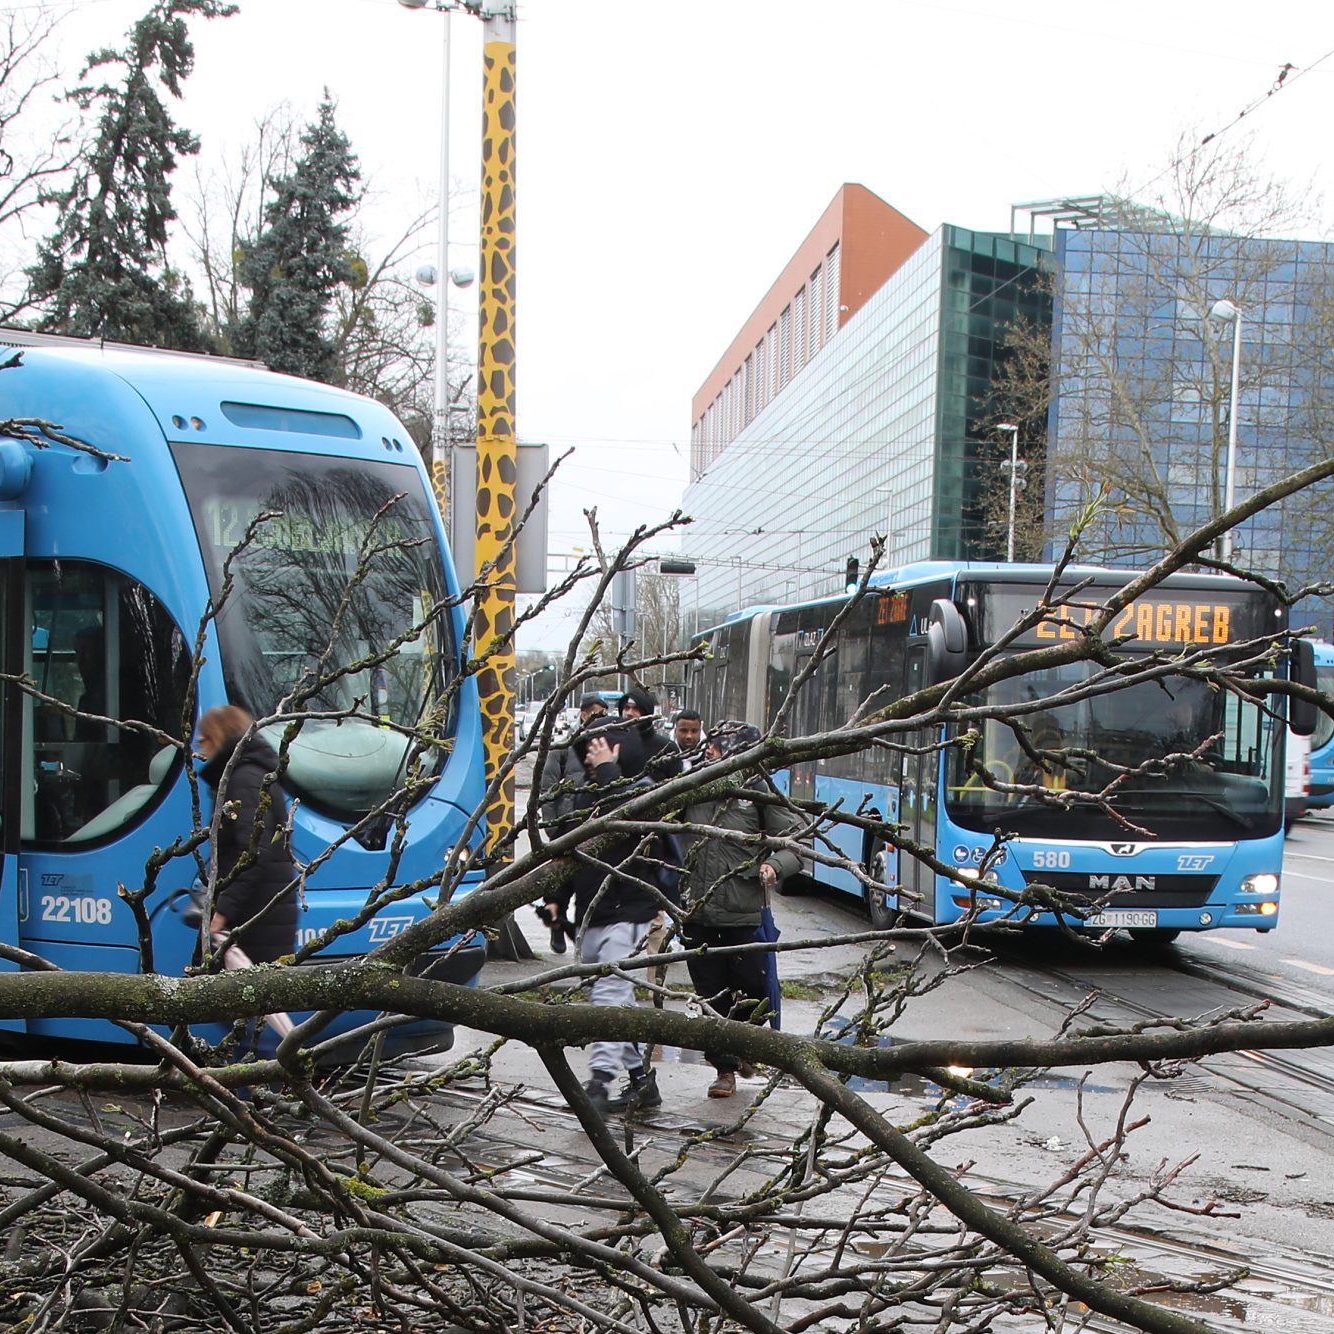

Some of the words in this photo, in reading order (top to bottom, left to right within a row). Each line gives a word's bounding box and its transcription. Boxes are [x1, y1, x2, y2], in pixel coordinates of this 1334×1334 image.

[1114, 602, 1230, 644] ZAGREB
[1033, 851, 1070, 868] 580
[1177, 855, 1215, 871] ZET
[41, 873, 65, 887] ZET
[1089, 875, 1156, 891] MAN
[41, 895, 113, 925] 22108
[1093, 914, 1106, 926] ZG
